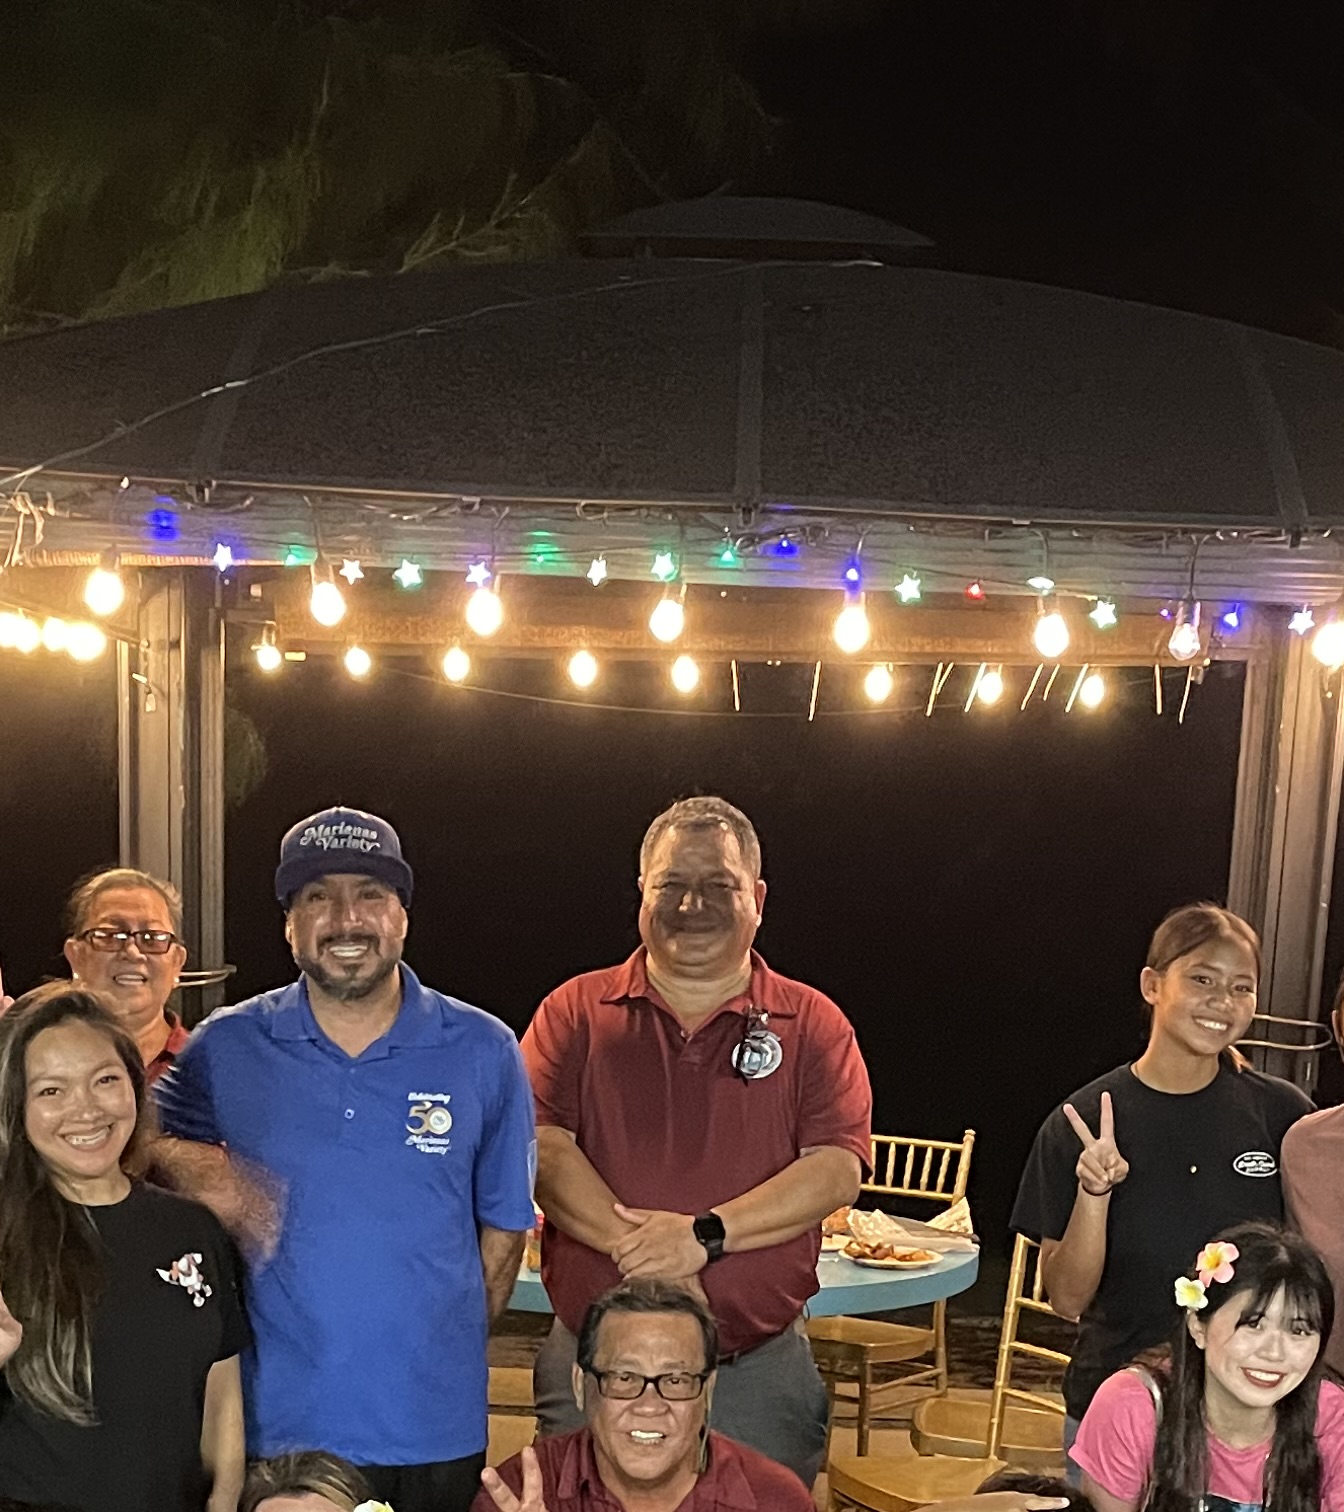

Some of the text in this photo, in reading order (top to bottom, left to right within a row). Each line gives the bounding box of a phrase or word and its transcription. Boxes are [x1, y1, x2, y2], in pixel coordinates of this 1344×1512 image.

[300, 822, 377, 845] Marianas
[316, 835, 380, 852] Variety
[406, 1101, 452, 1135] 50
